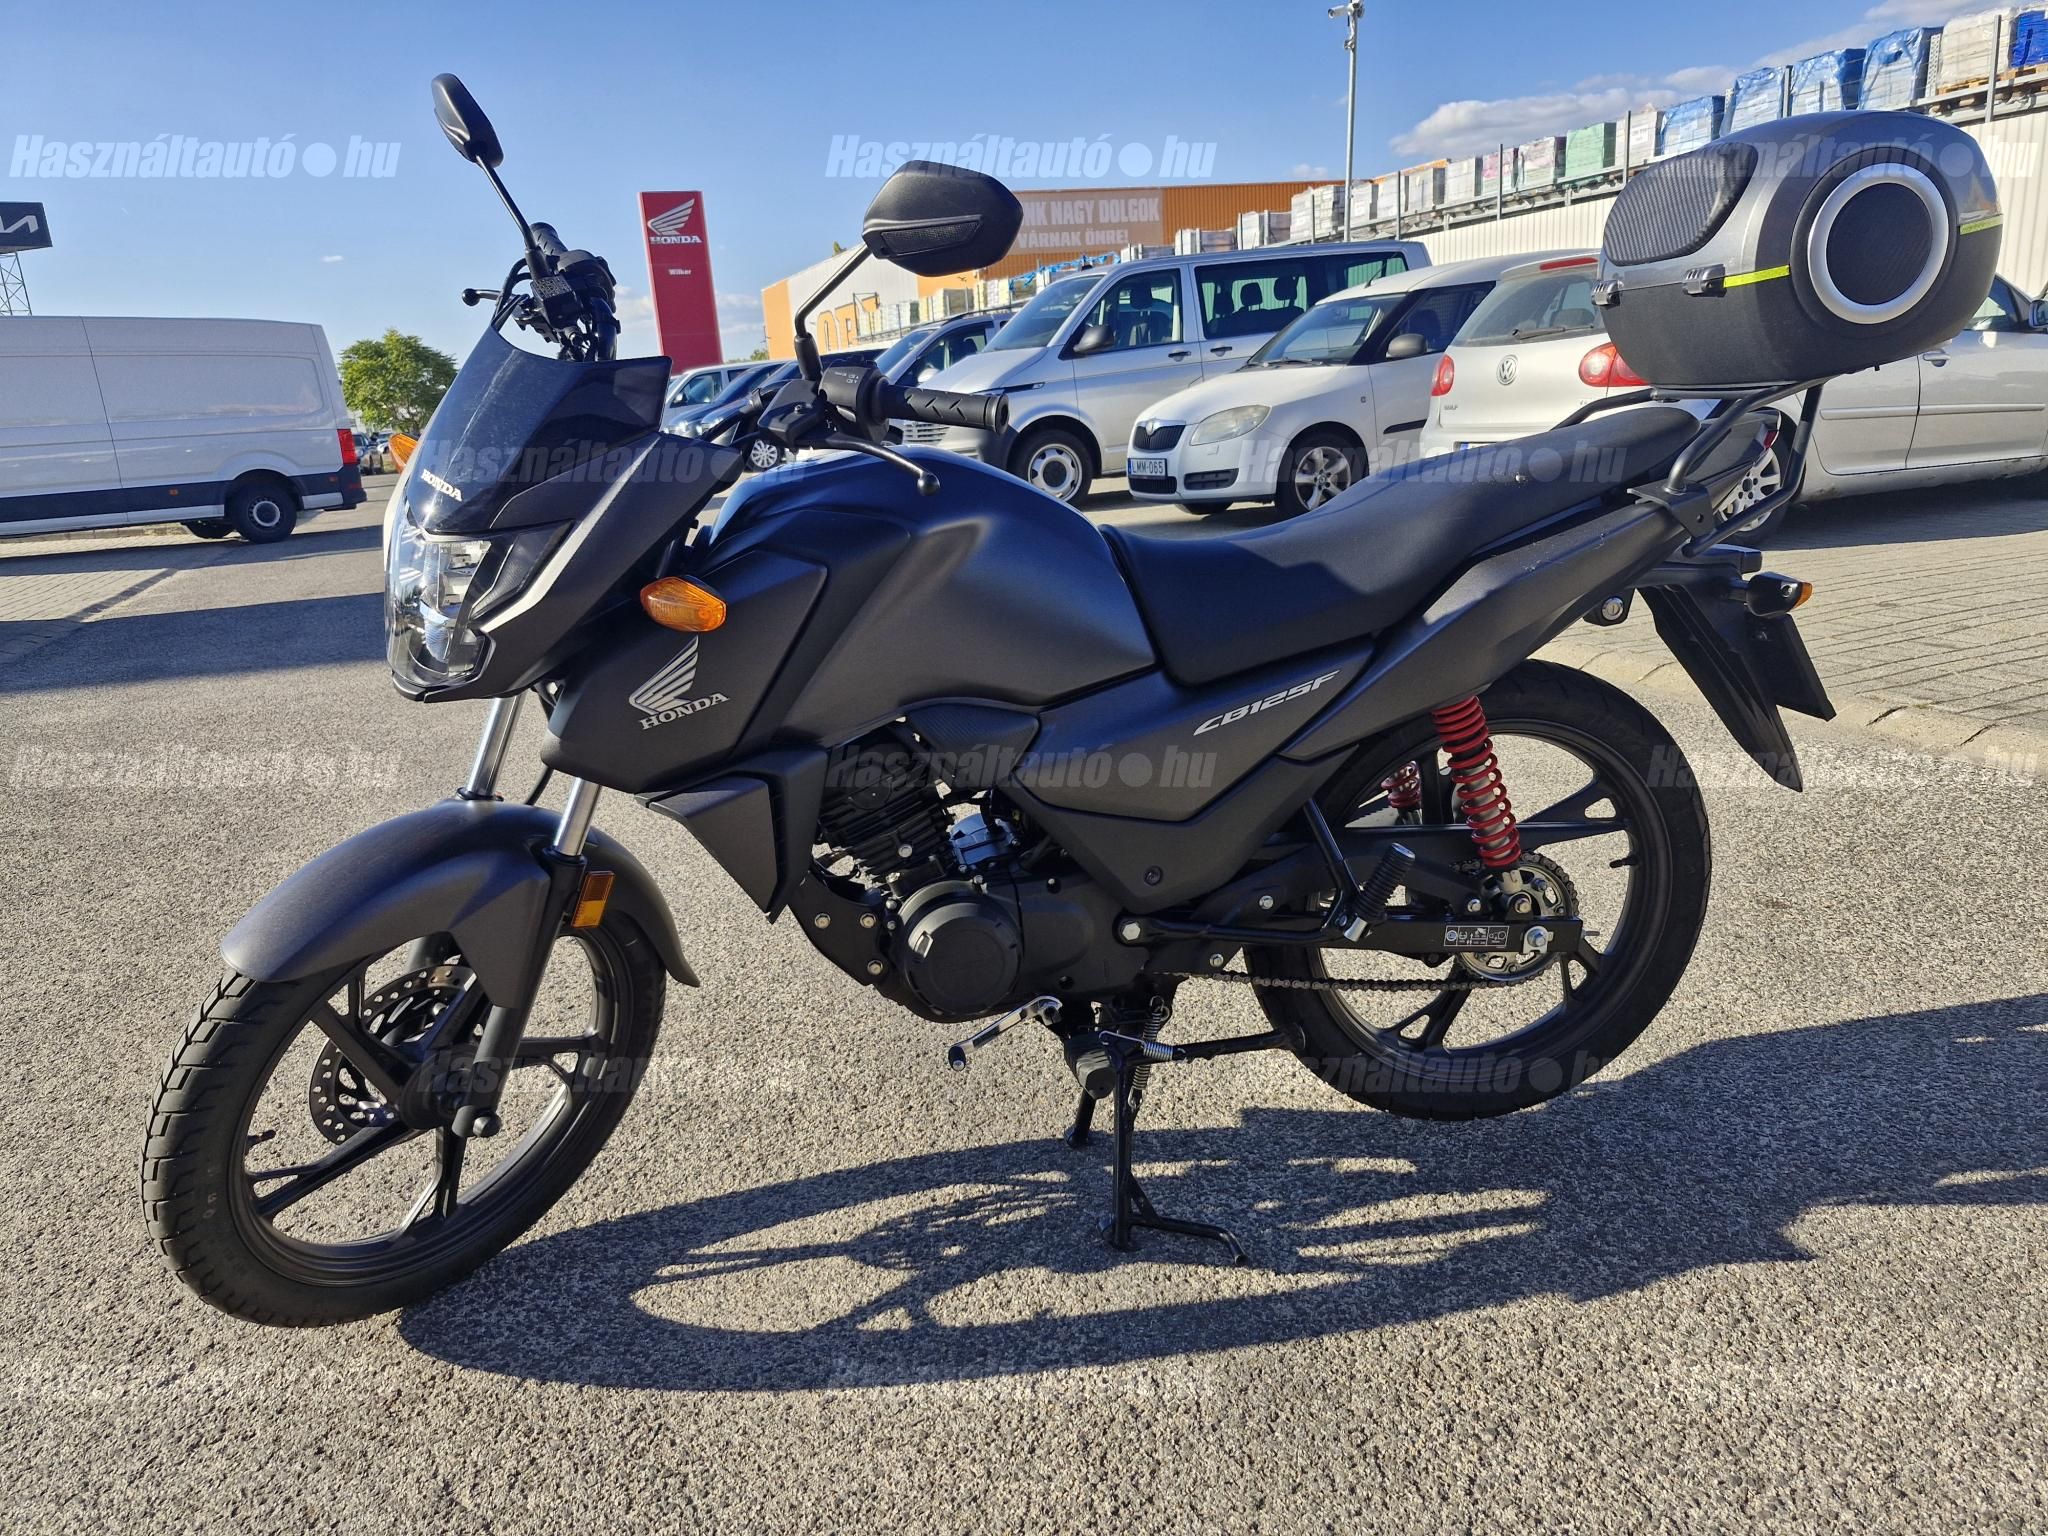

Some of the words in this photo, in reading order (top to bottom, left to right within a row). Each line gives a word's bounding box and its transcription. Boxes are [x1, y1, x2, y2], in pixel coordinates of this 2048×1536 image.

[1051, 200, 1094, 225] NAGY
[1099, 198, 1160, 223] DOLGOK
[649, 235, 702, 244] HONDA
[420, 469, 463, 501] HONDA
[640, 693, 730, 730] HONDA
[1193, 670, 1341, 737] CB125F
